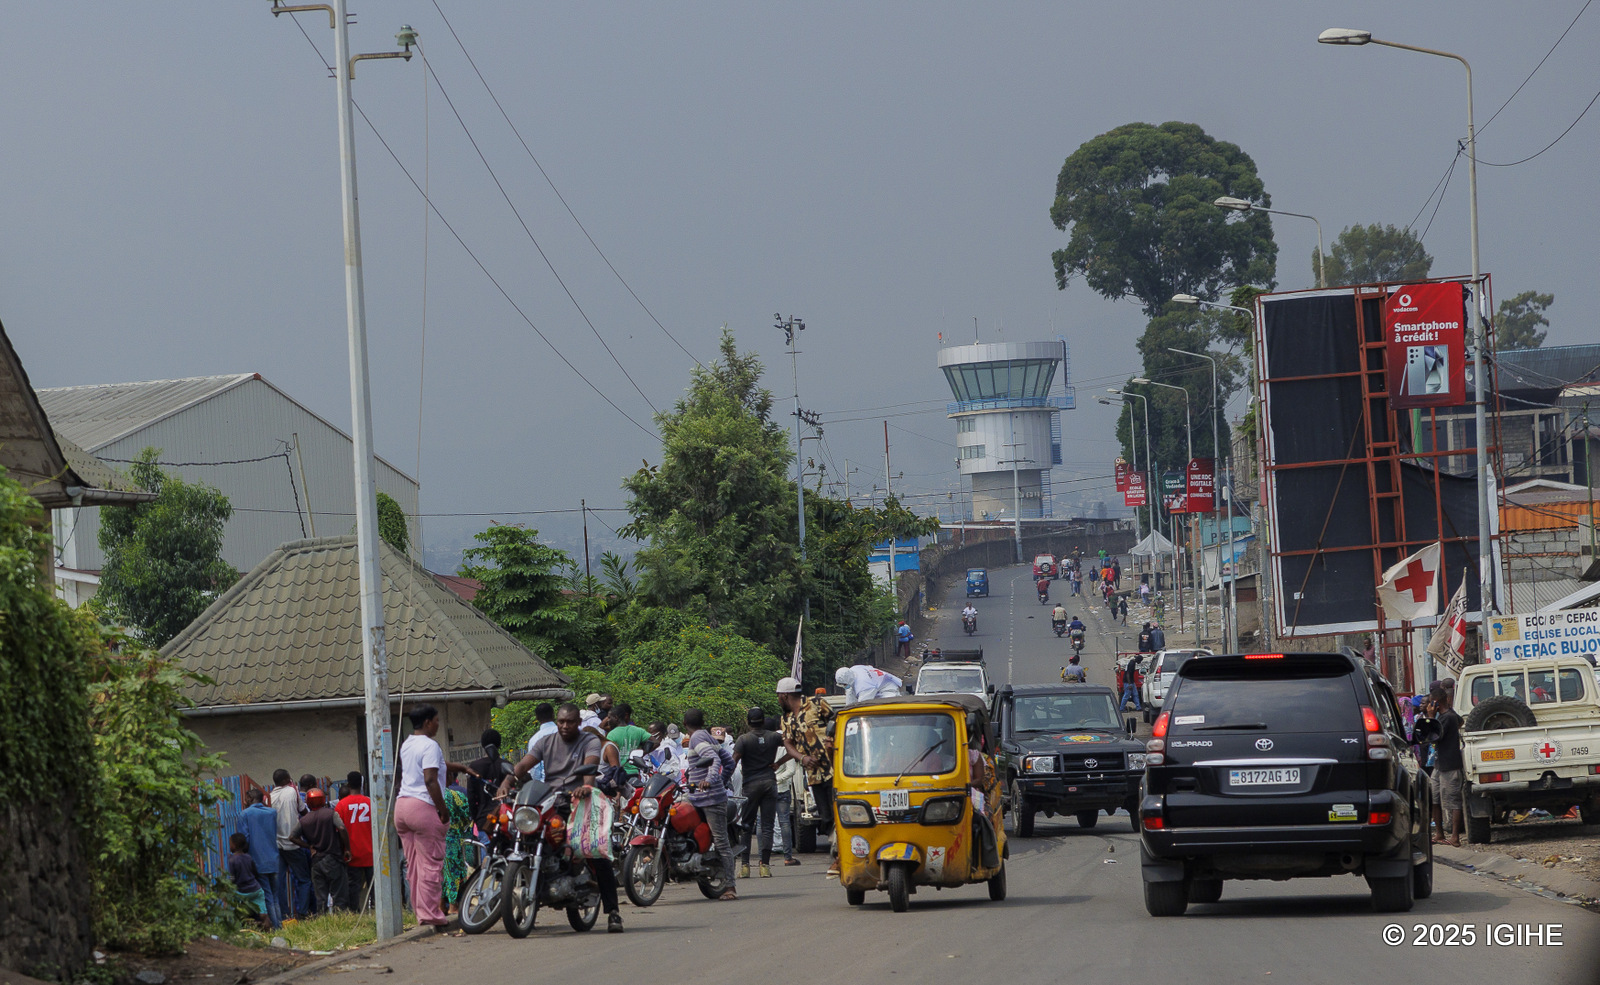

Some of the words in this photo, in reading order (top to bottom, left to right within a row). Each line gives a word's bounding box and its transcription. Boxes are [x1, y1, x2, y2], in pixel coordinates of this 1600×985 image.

[1394, 320, 1458, 332] Smartphone
[1394, 332, 1401, 342] à
[1402, 332, 1434, 342] crédit
[1434, 331, 1438, 340] !
[1566, 612, 1598, 623] CEPAC
[1524, 628, 1561, 640] EGLISE
[1514, 642, 1557, 658] CEPAC
[1571, 747, 1588, 755] 17459
[1240, 770, 1282, 783] 8172AG
[1285, 769, 1298, 782] 19
[348, 803, 370, 824] 72
